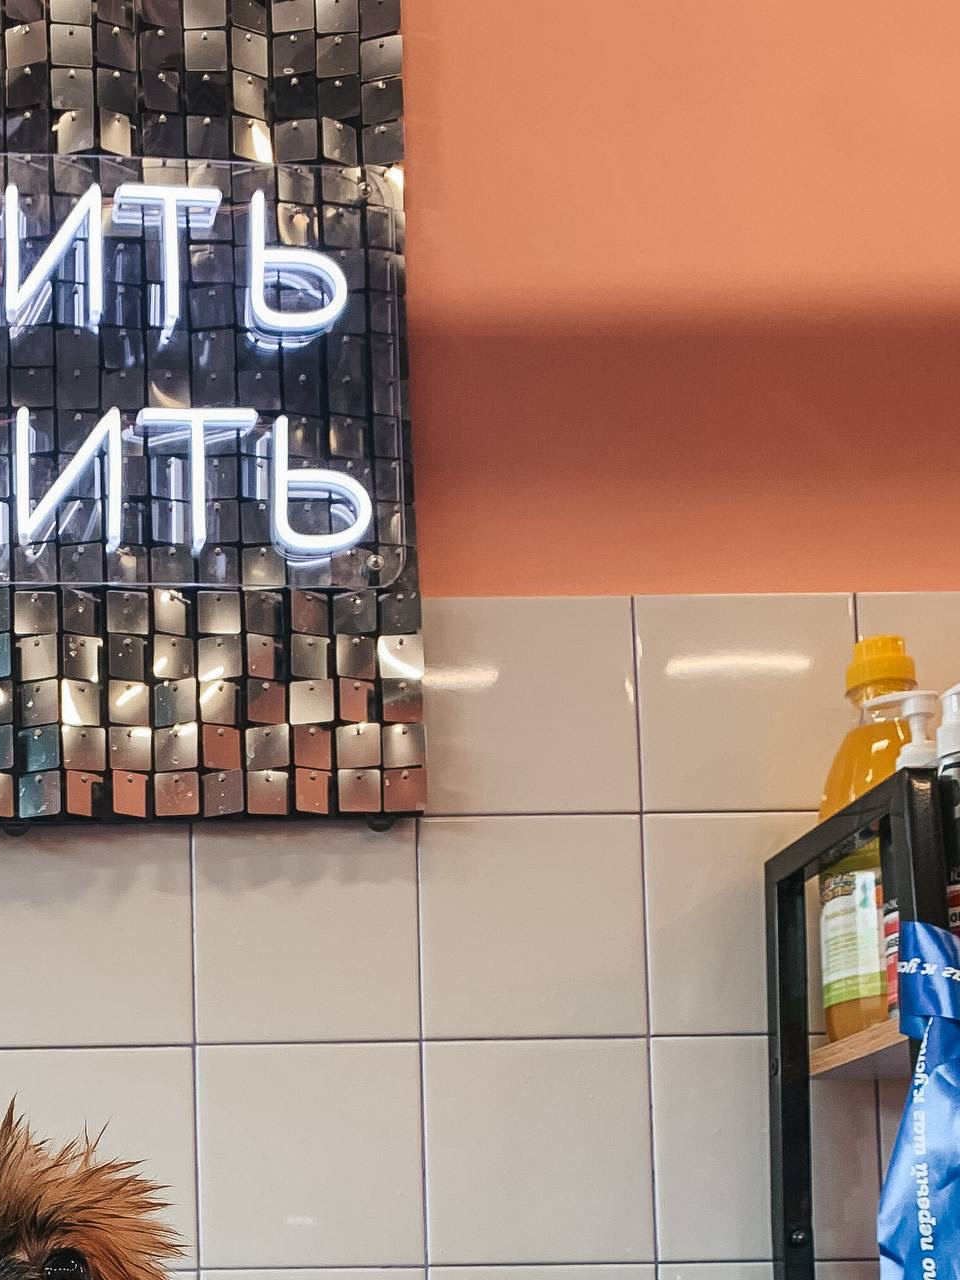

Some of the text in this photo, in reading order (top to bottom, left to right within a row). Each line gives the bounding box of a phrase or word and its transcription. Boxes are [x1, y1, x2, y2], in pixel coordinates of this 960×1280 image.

[912, 1088, 926, 1104] к
[912, 1110, 927, 1156] шаг
[910, 1162, 937, 1251] первый
